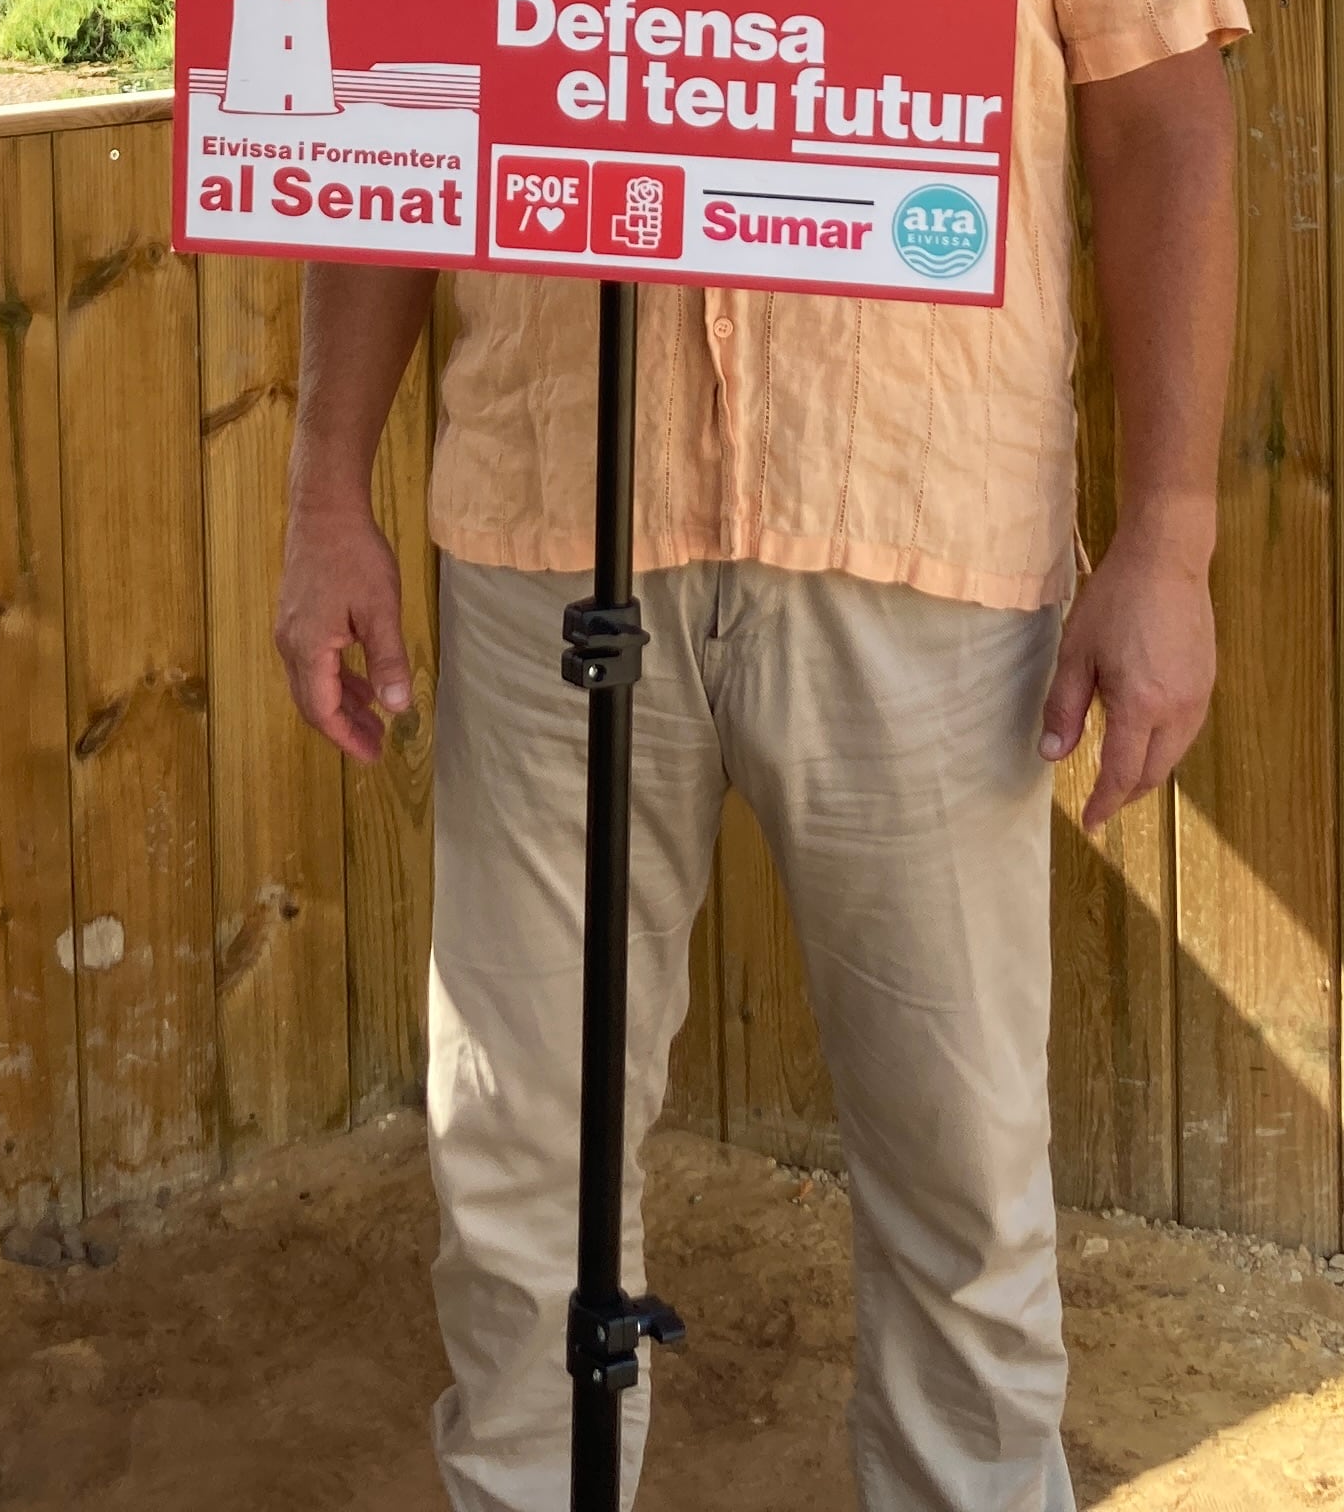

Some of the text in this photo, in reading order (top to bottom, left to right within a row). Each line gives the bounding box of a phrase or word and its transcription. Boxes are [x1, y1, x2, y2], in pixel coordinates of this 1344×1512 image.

[557, 55, 1002, 144] el teu futur
[203, 136, 462, 170] Eivissa i Formentera
[200, 165, 463, 227] al Senat
[506, 173, 579, 205] PSOE
[703, 201, 873, 250] Sumar
[903, 202, 978, 235] ara
[907, 233, 971, 248] EIVISSA
